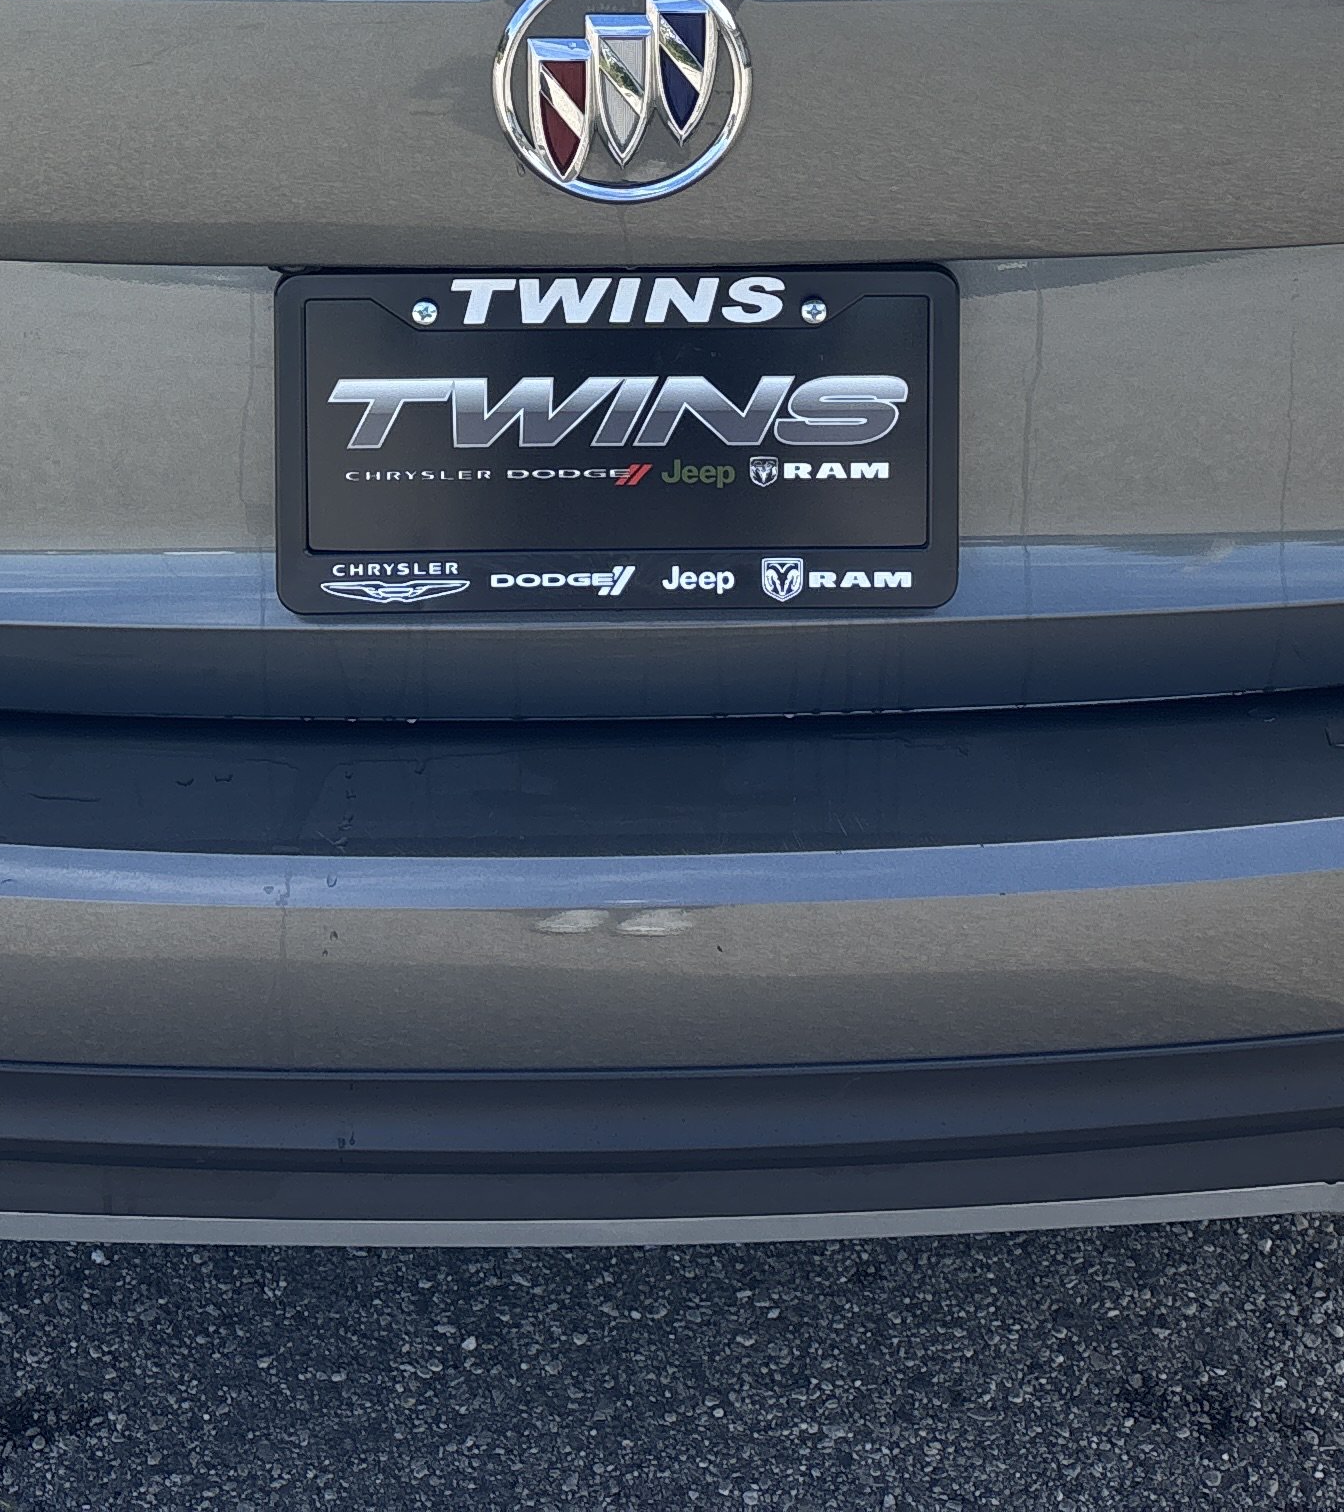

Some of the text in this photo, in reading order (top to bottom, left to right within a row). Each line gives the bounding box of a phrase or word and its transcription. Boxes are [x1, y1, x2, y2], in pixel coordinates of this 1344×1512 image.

[450, 276, 786, 325] TWINS
[328, 375, 910, 449] TWINS
[345, 459, 890, 488] CHRYSLER DODGE Jeep RAM
[332, 562, 912, 594] CHRYSLER DODGE Jeep RAM
